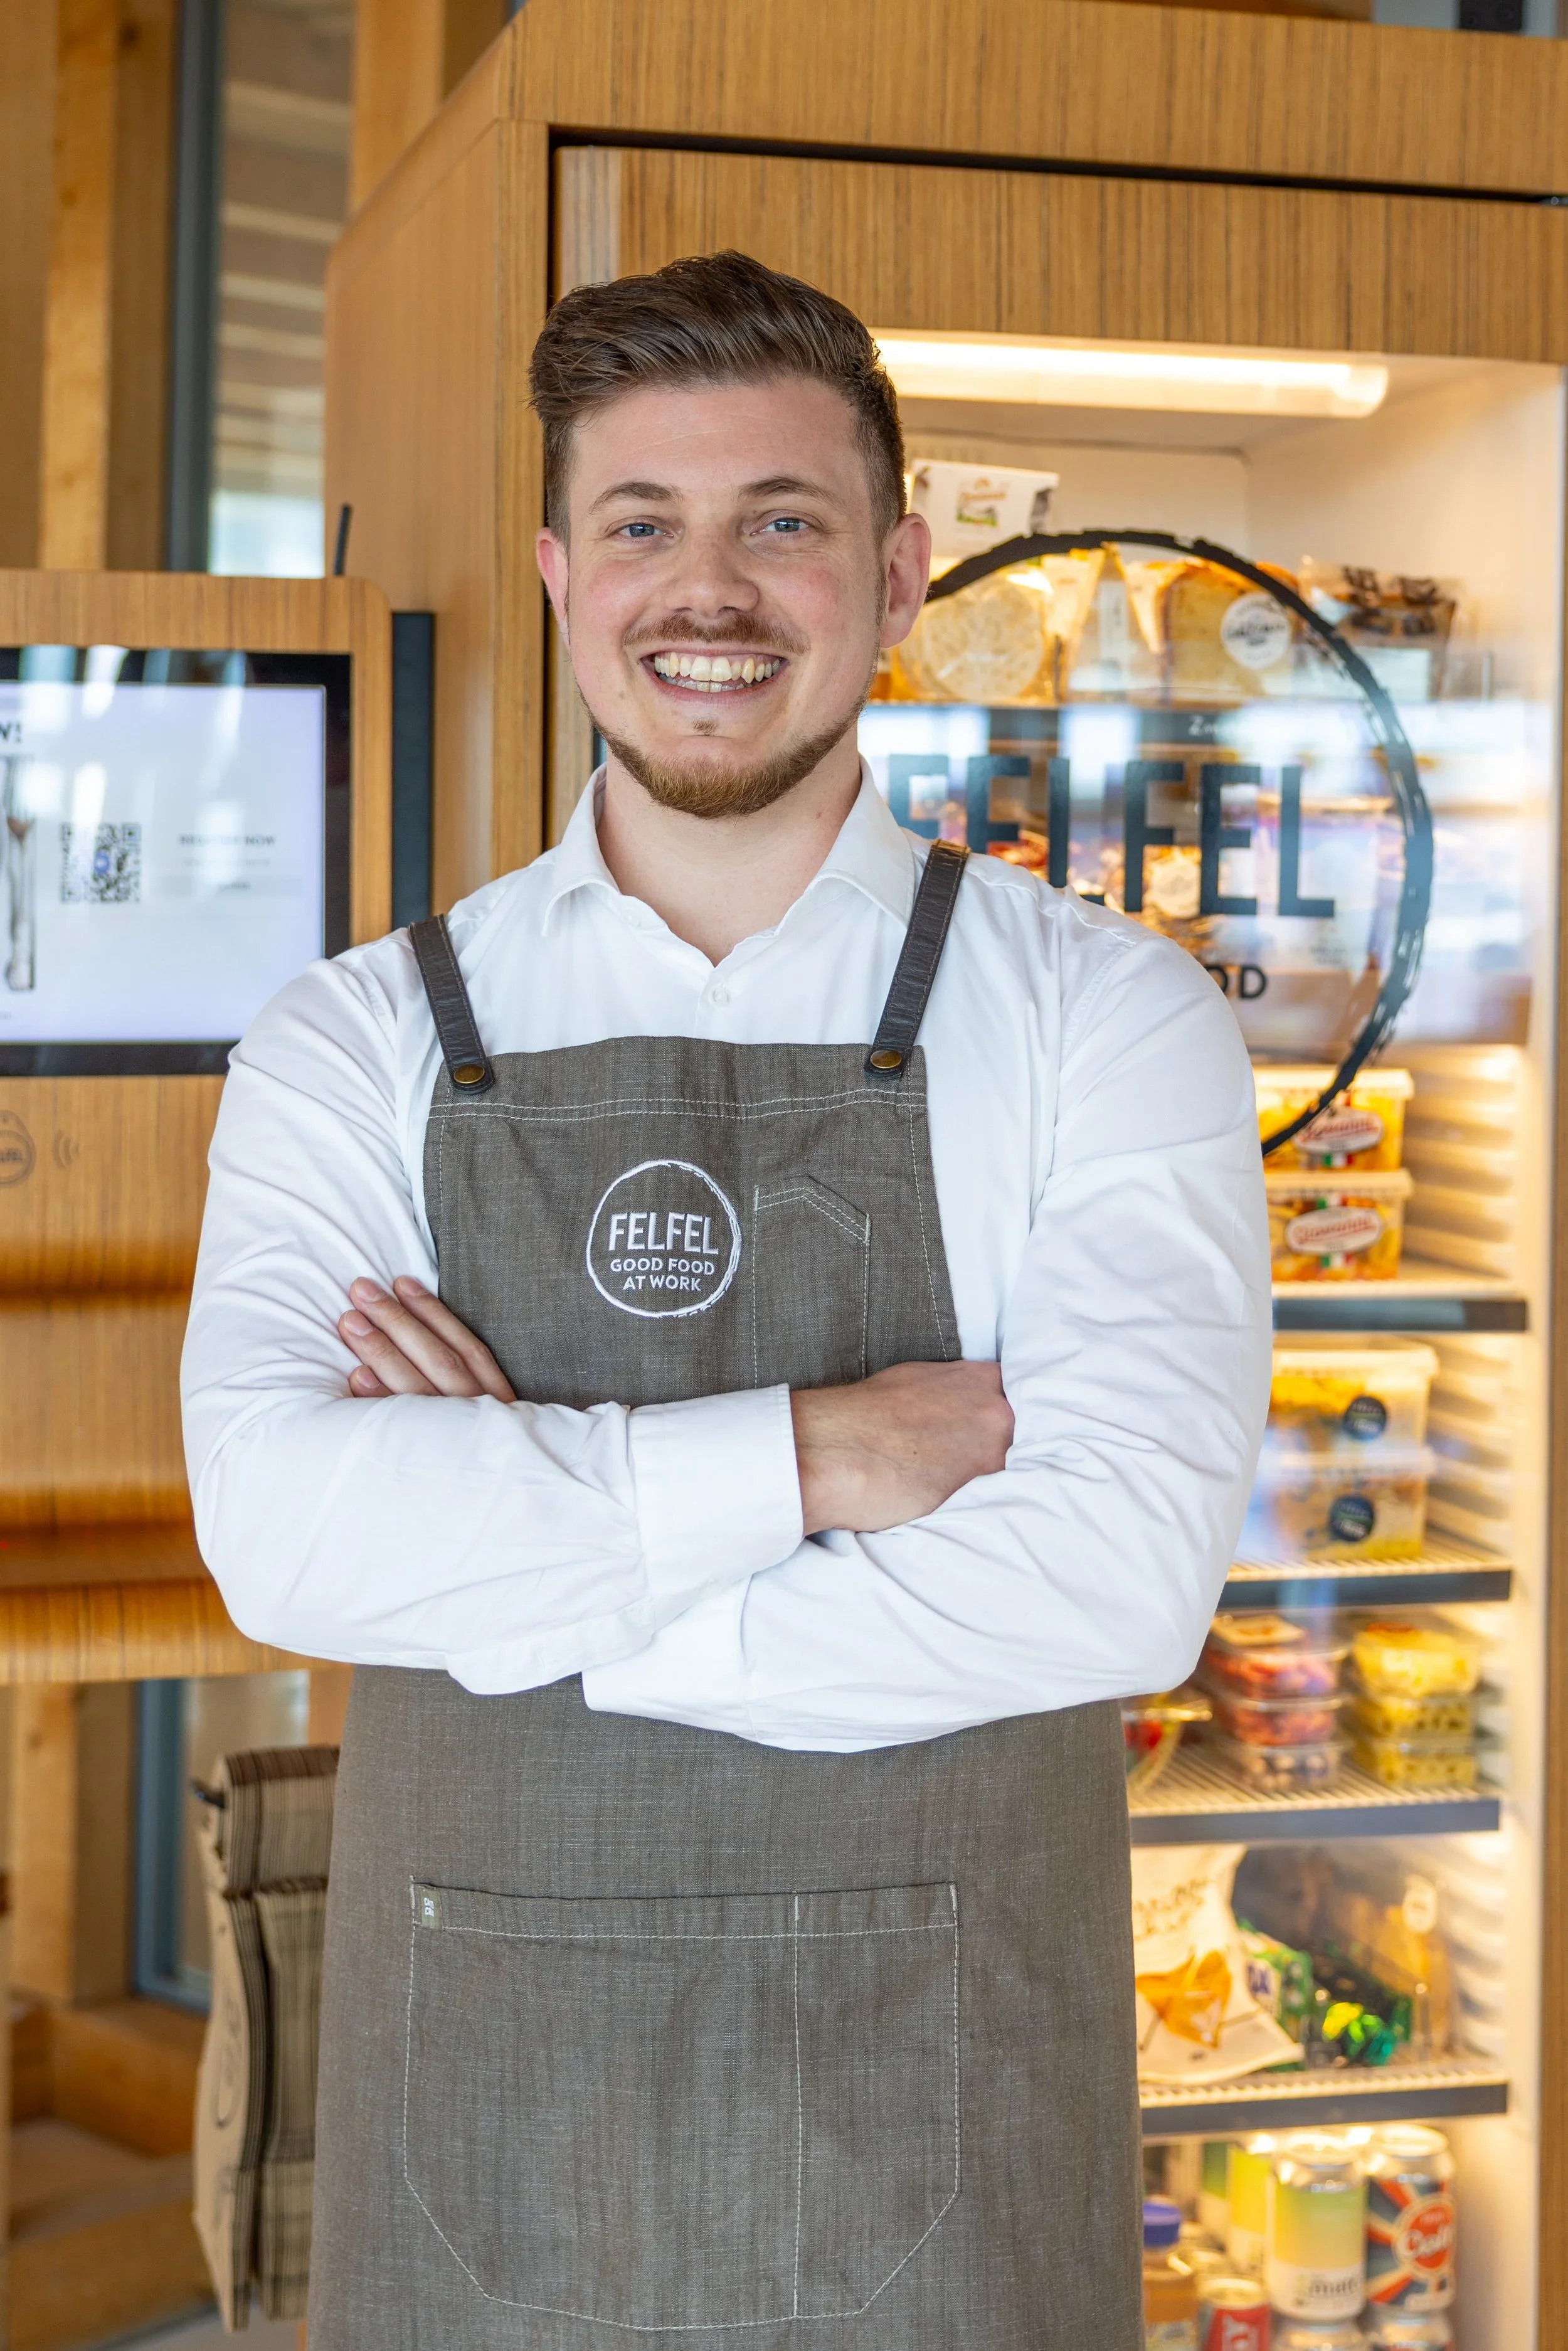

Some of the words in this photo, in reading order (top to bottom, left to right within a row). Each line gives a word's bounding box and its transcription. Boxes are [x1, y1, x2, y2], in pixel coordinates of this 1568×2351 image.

[889, 755, 1334, 917] FELFEL
[608, 1212, 719, 1254] FELFEL
[610, 1257, 663, 1272] GOOD
[668, 1258, 716, 1275] FOOD
[623, 1275, 646, 1290] AT
[650, 1275, 702, 1291] WORK
